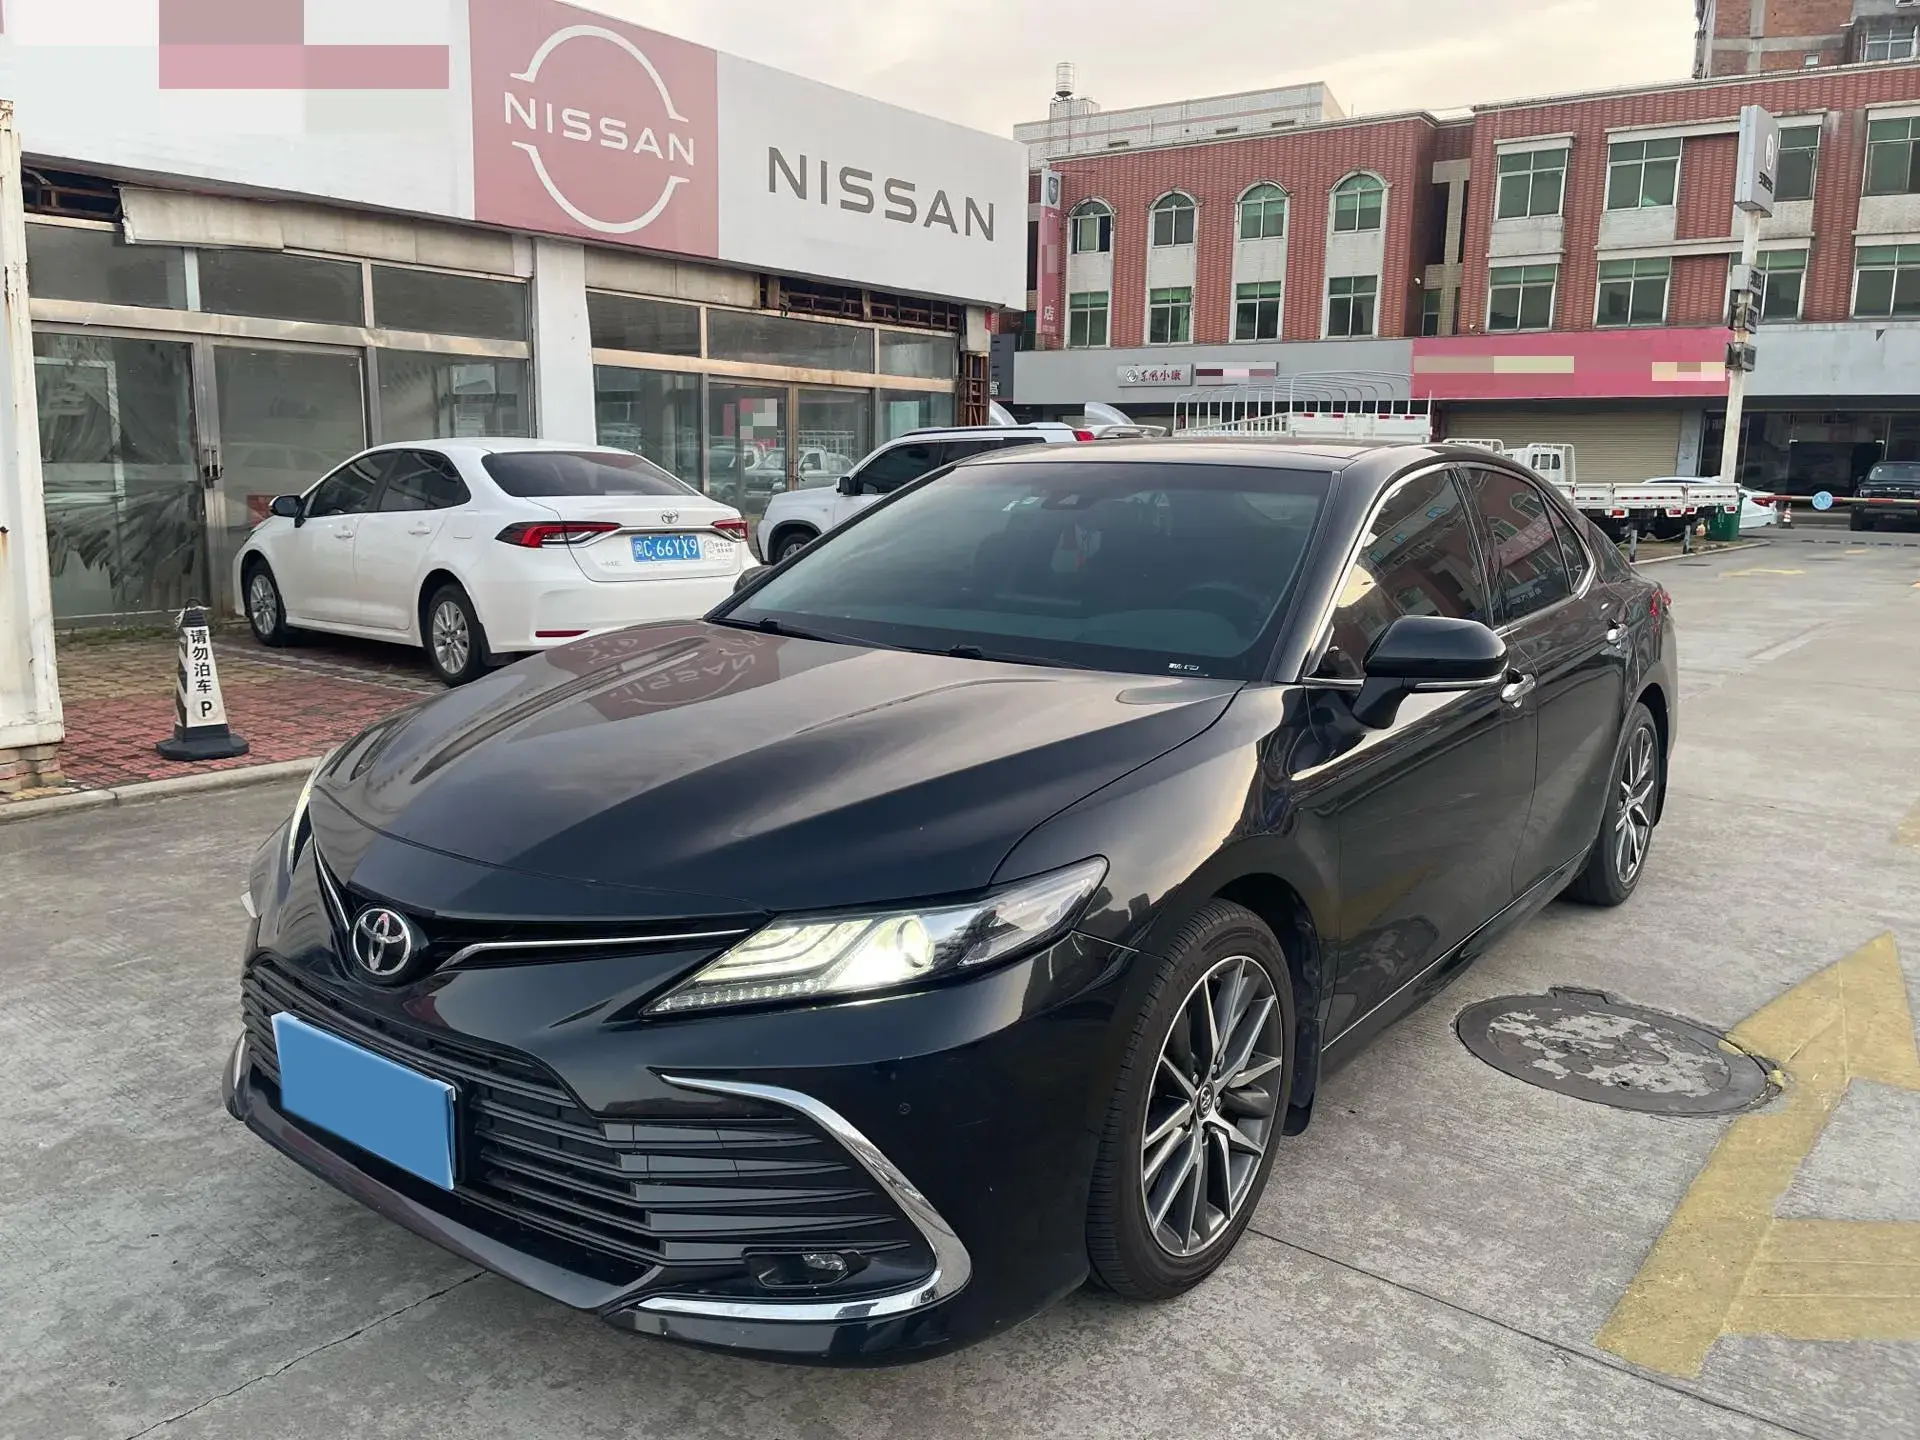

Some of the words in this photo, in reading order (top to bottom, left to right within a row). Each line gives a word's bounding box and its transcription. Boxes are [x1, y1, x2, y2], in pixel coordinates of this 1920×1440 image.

[504, 91, 694, 166] NISSAN
[768, 146, 994, 241] NISSAN
[189, 629, 212, 694] 请勿泊车
[201, 701, 213, 717] P
